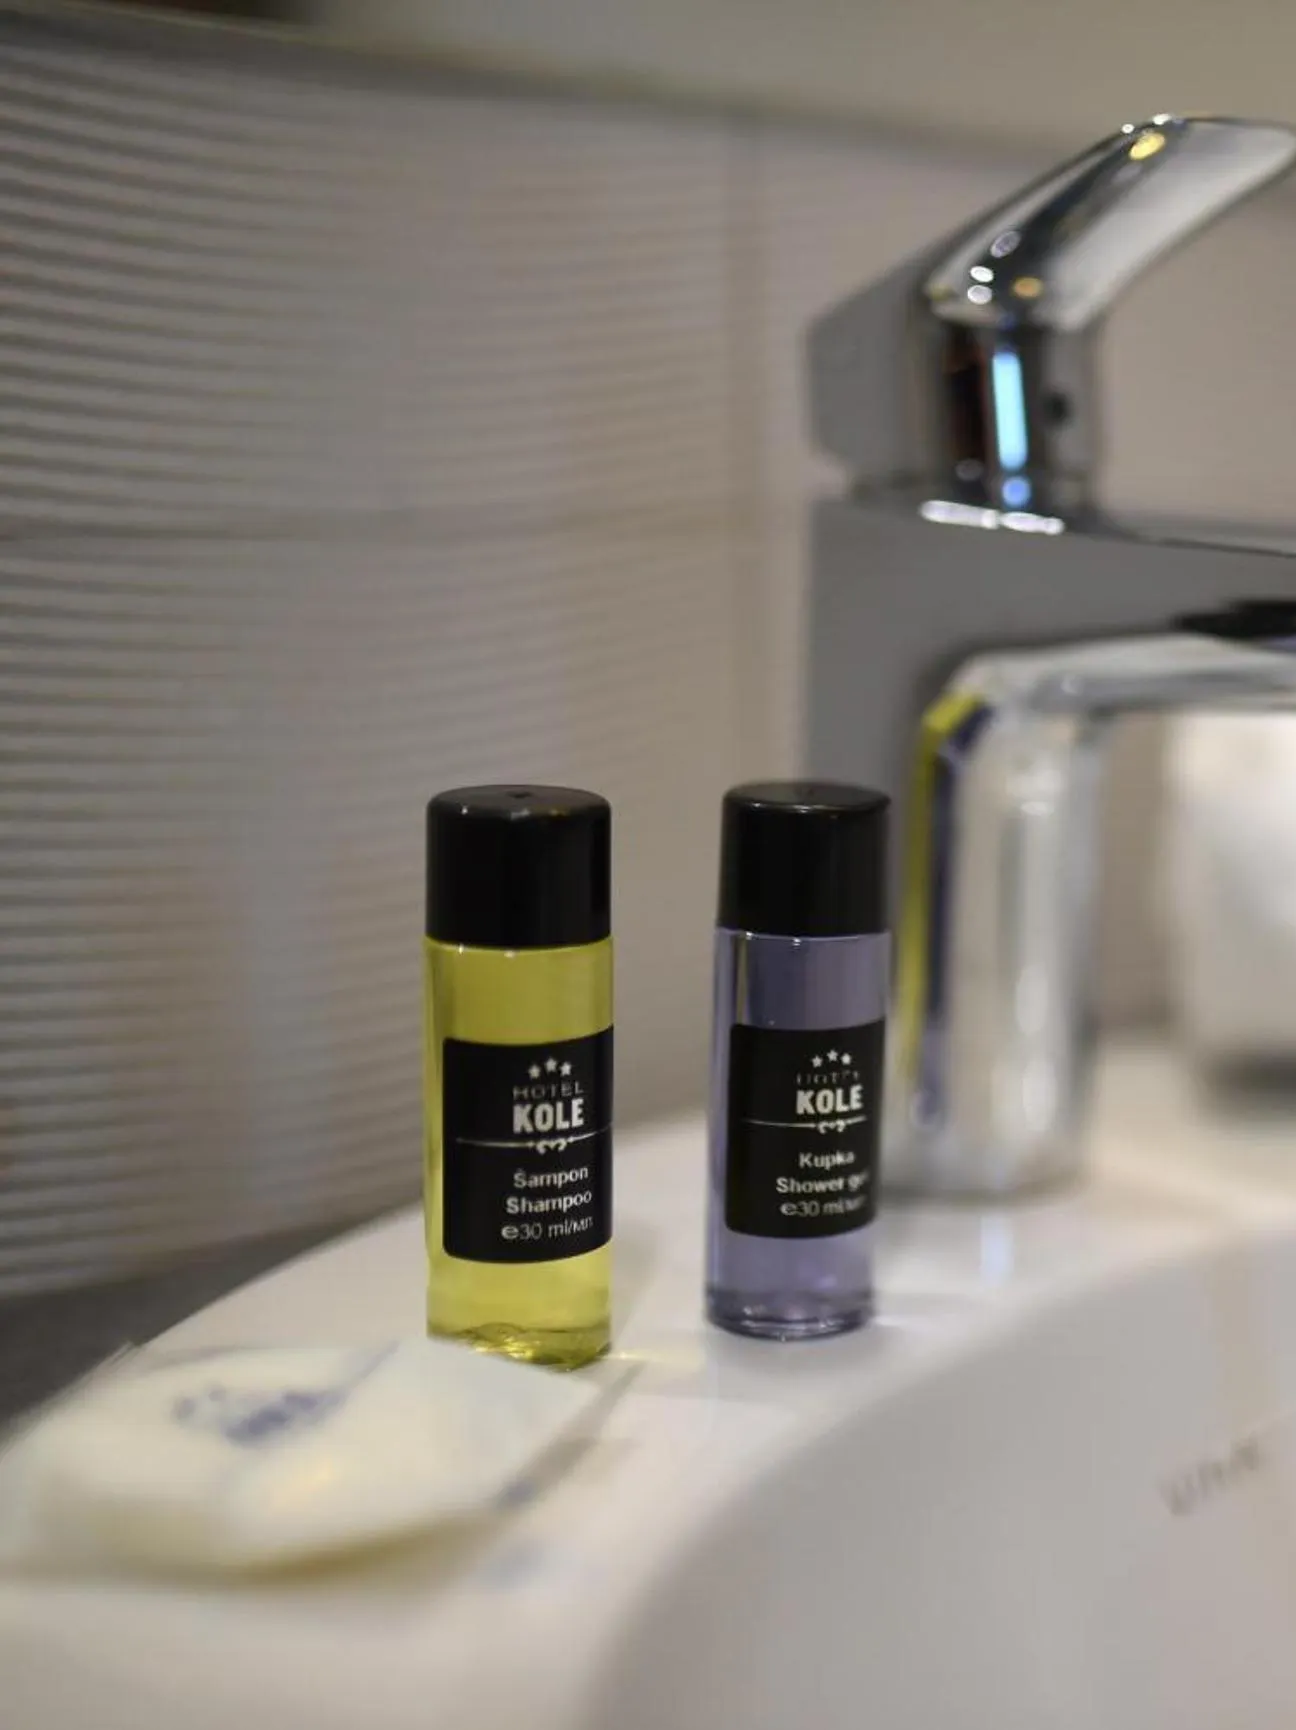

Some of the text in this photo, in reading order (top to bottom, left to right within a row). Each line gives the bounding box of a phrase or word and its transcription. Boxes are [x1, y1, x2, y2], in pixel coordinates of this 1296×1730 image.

[512, 1081, 584, 1100] HOTEL
[796, 1084, 864, 1115] KOLE
[512, 1098, 585, 1134] KOLE
[799, 1150, 856, 1170] Kupka
[776, 1176, 845, 1194] Shower
[506, 1190, 592, 1214] Shampoo
